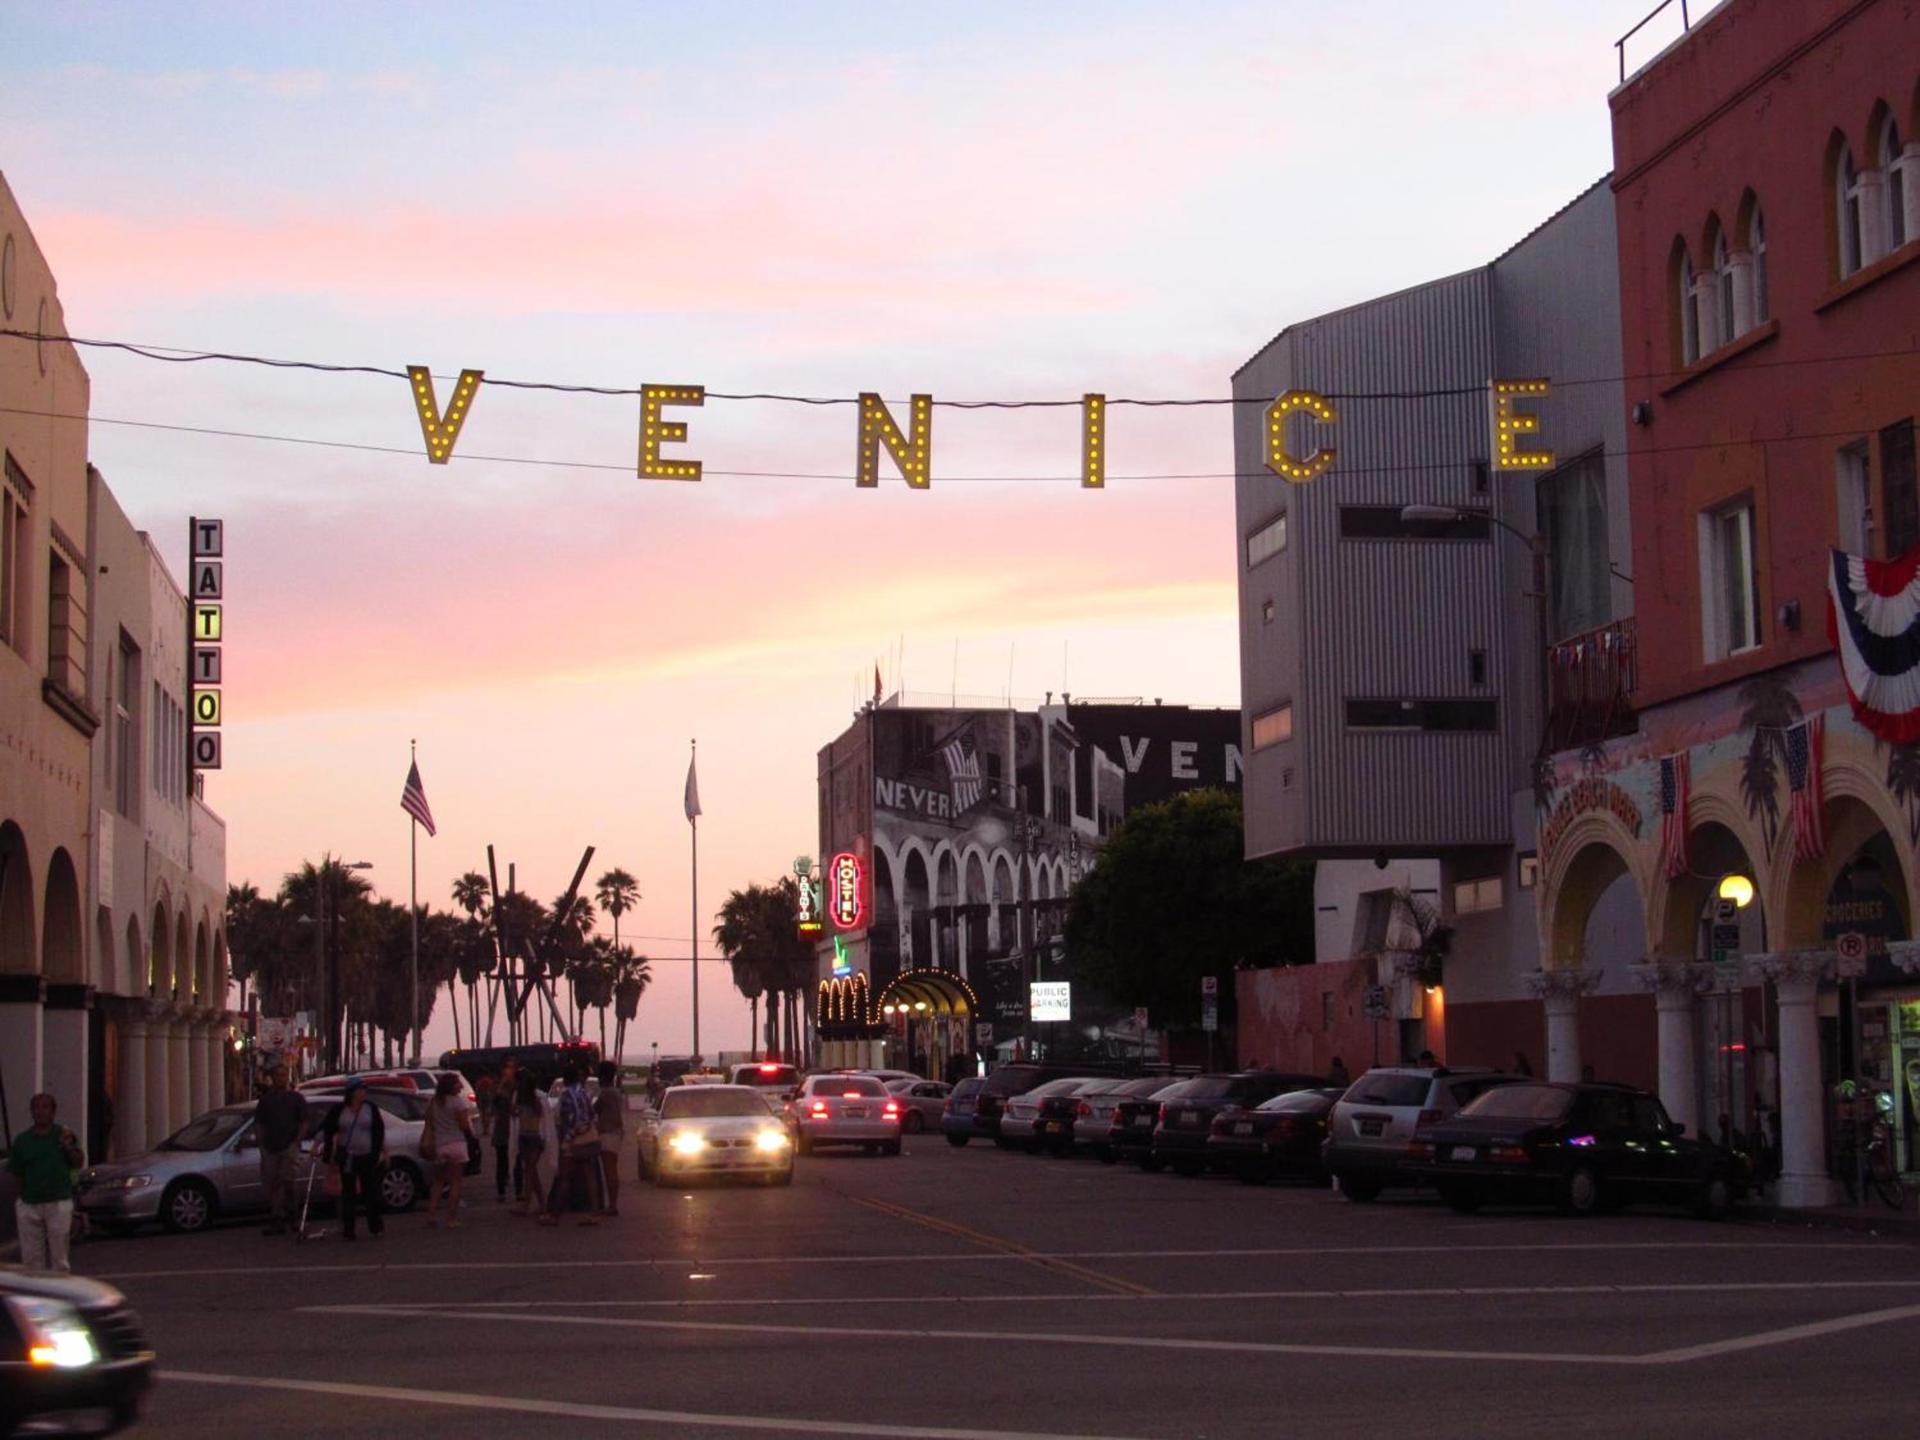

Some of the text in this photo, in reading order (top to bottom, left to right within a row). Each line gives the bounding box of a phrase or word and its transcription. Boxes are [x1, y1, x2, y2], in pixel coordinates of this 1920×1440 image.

[406, 364, 1556, 490] VENICE
[197, 524, 217, 763] TATTOO
[1119, 734, 1244, 783] VEN
[875, 776, 950, 819] NEVER
[840, 858, 854, 923] HOSTEL
[1030, 987, 1068, 997] PUBLIC
